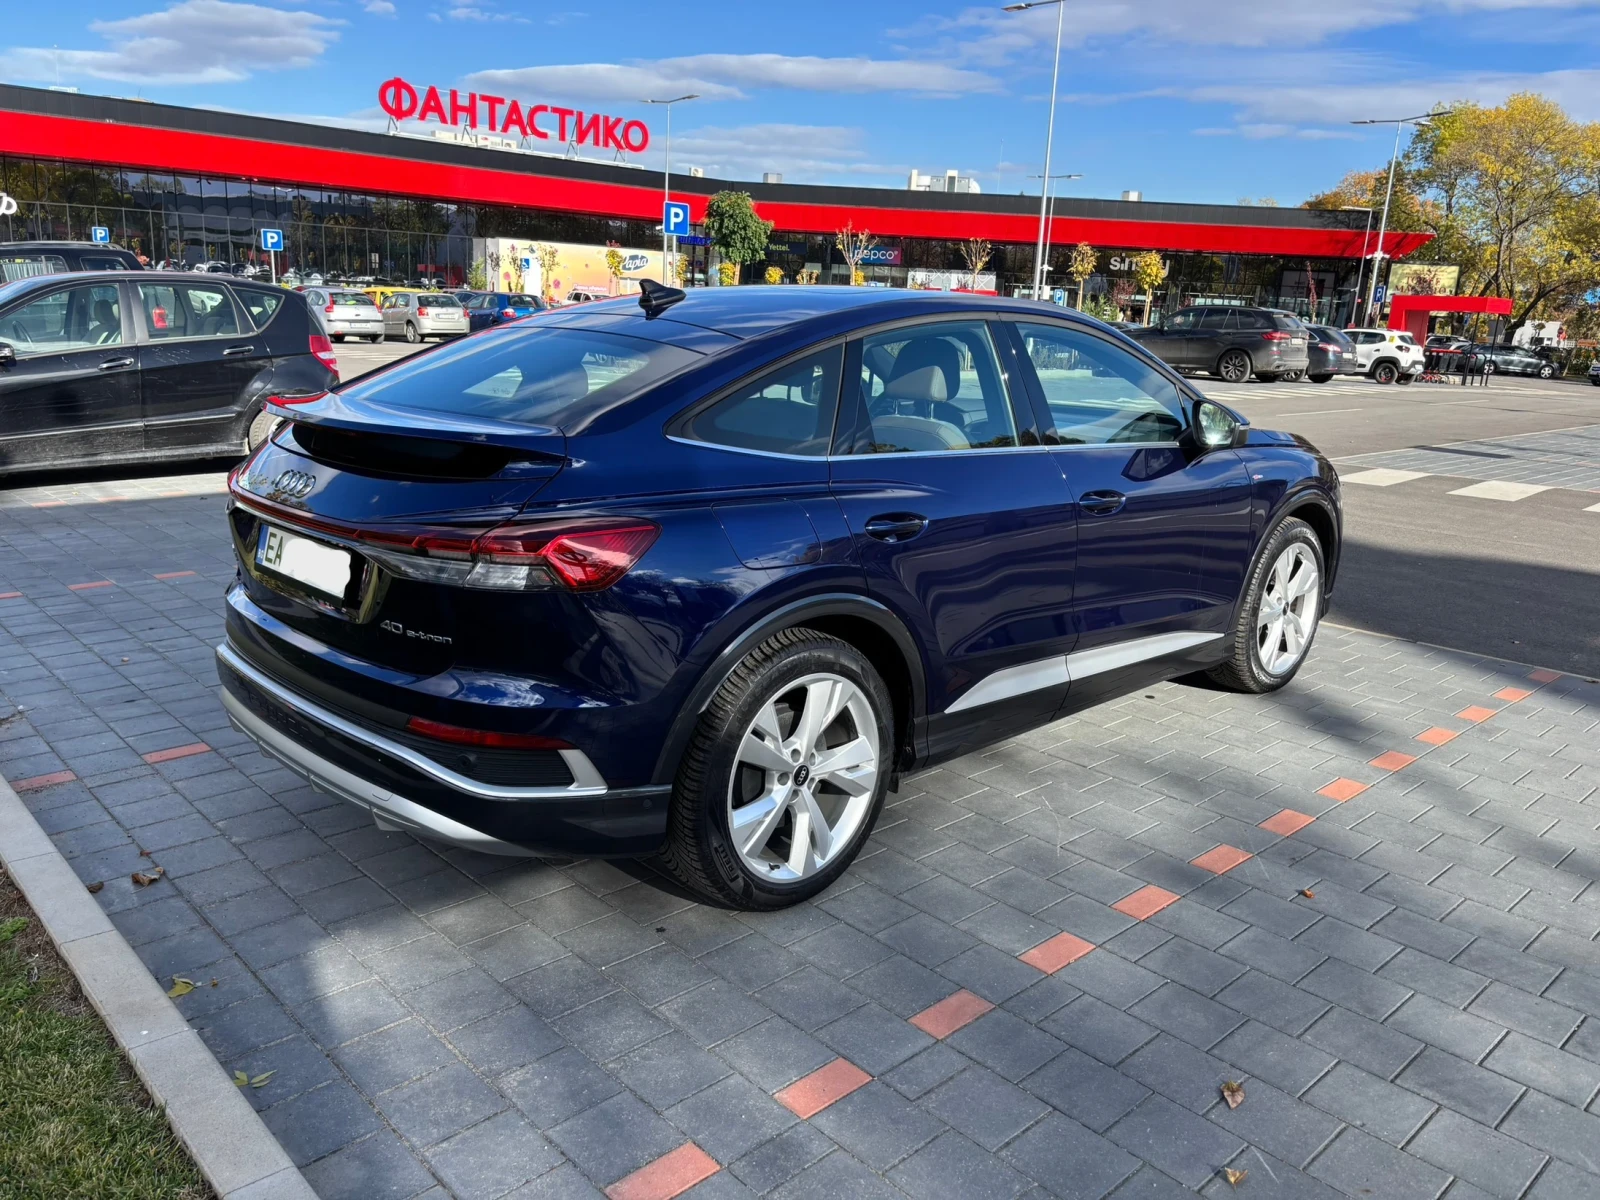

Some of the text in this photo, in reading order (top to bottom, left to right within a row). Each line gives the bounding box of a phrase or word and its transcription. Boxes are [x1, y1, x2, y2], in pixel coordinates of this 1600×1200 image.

[378, 76, 650, 153] ФАНТАСТИКО
[669, 207, 684, 231] P
[96, 230, 106, 241] P
[267, 232, 278, 247] P
[380, 619, 453, 645] 40 e-tron
